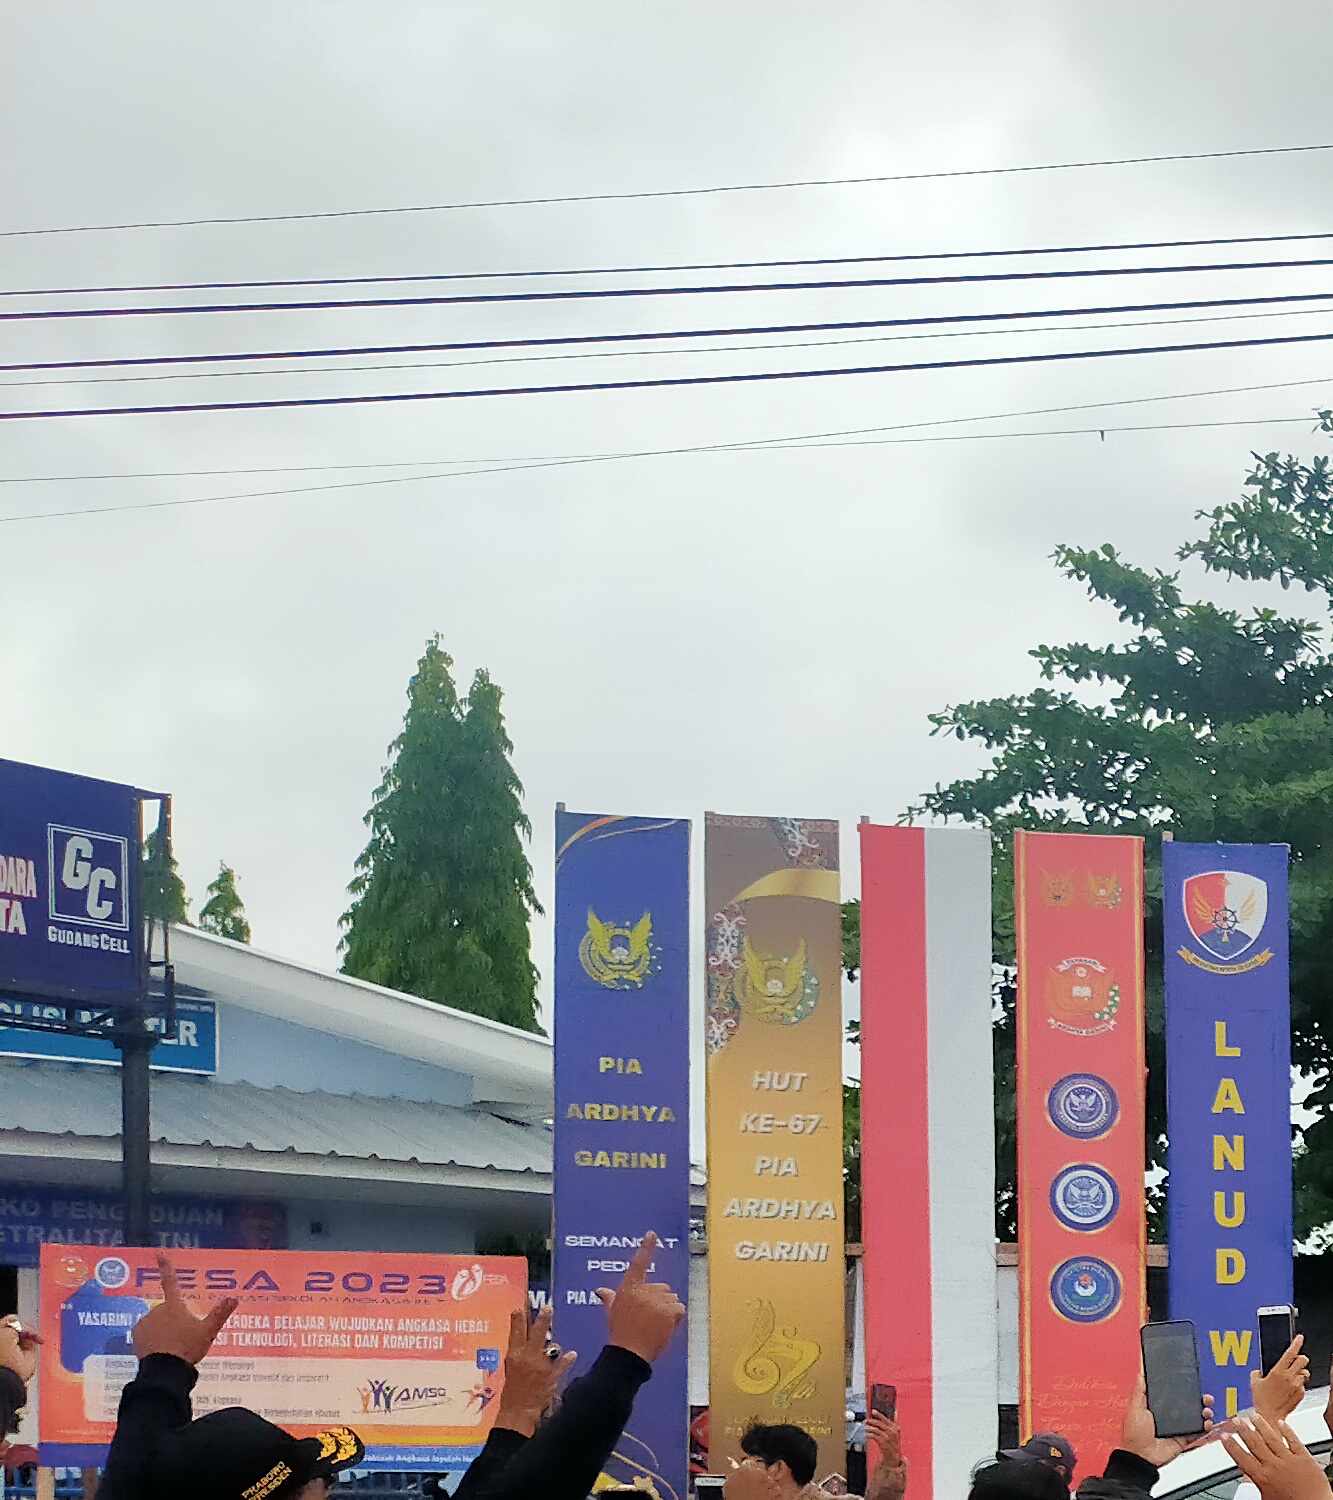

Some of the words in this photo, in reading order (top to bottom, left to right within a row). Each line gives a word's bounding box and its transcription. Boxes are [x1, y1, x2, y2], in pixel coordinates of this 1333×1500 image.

[61, 835, 117, 920] GC
[599, 1056, 643, 1074] PIA
[752, 1071, 810, 1092] HUT
[567, 1102, 677, 1122] ARDHYA
[740, 1113, 822, 1134] KE-67
[574, 1150, 668, 1169] GARINI
[1210, 1020, 1246, 1285] LANUD
[756, 1156, 799, 1177] PIA
[723, 1198, 837, 1220] ARDHYA
[735, 1240, 830, 1262] GARINI
[135, 1267, 280, 1292] FESA
[305, 1271, 447, 1295] 2023
[301, 1333, 350, 1348] LITERASI
[354, 1335, 379, 1348] DAN
